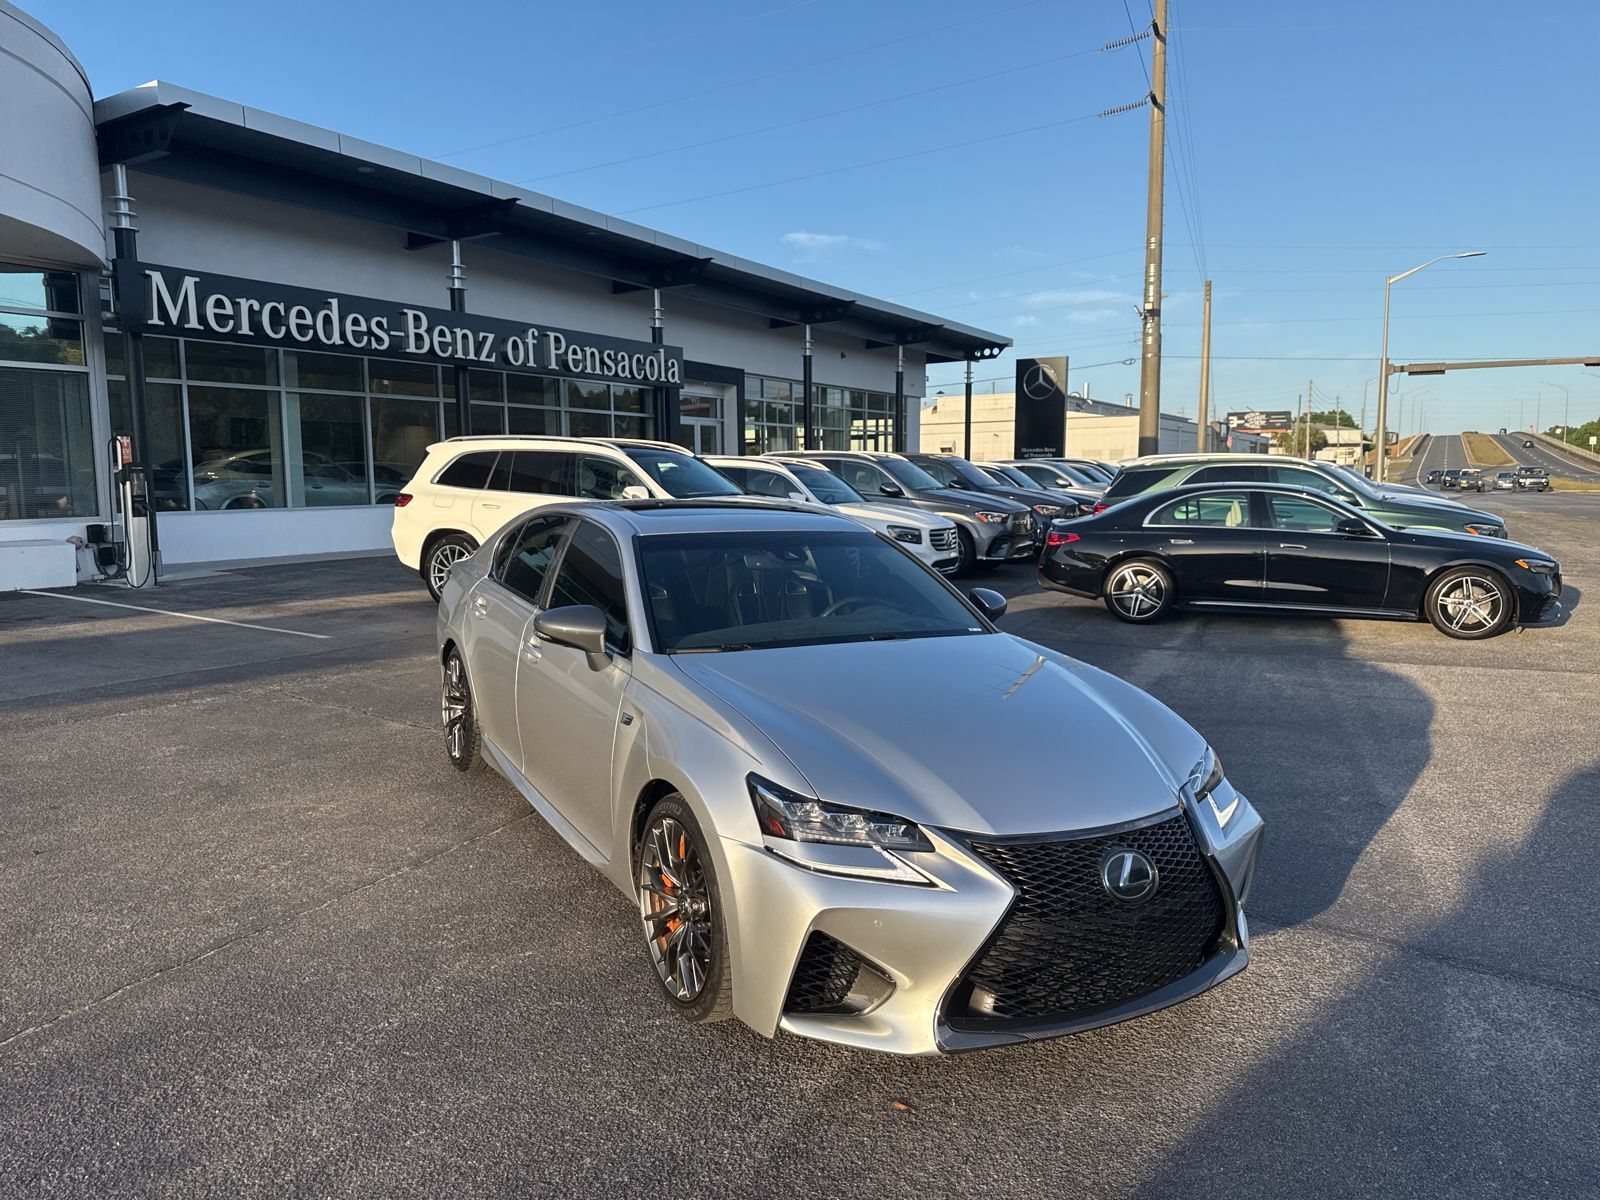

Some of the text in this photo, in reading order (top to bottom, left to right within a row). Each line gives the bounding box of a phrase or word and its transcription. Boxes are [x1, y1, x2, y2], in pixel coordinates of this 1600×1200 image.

[145, 270, 681, 383] Mercedes-Benz of Pensacola
